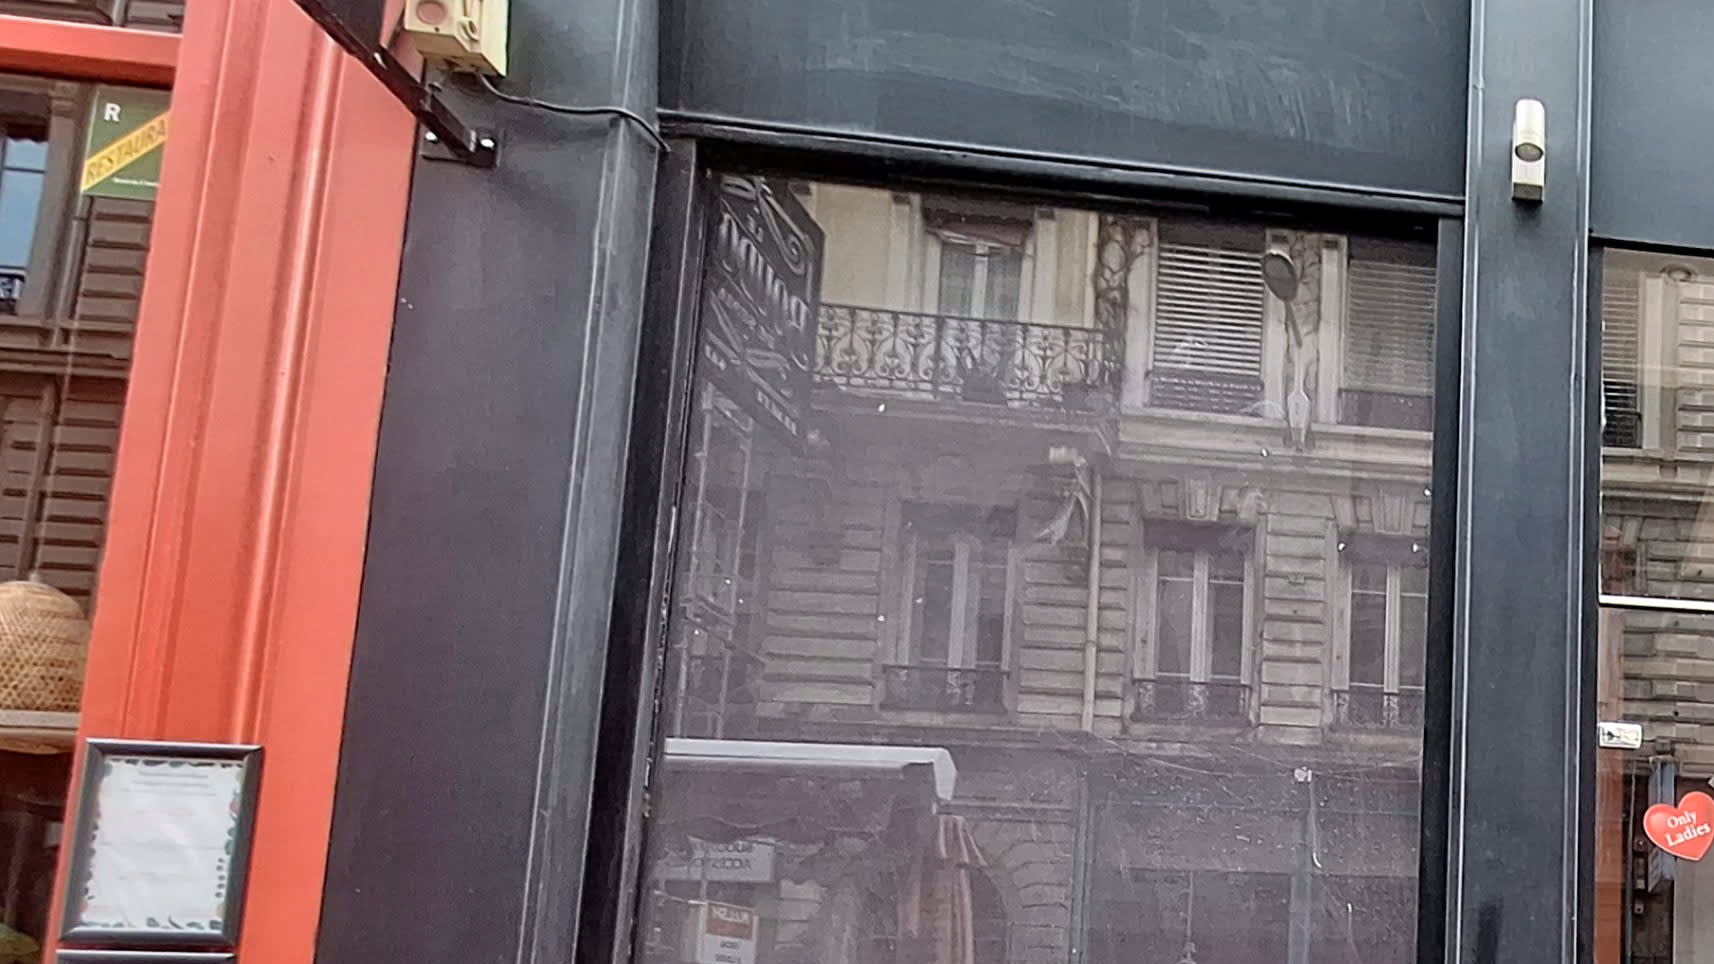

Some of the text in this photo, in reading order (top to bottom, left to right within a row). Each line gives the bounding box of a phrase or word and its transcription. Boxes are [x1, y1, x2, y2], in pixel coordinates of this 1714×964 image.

[104, 102, 121, 122] R
[1667, 810, 1697, 828] Only
[1665, 823, 1711, 847] Ladies
